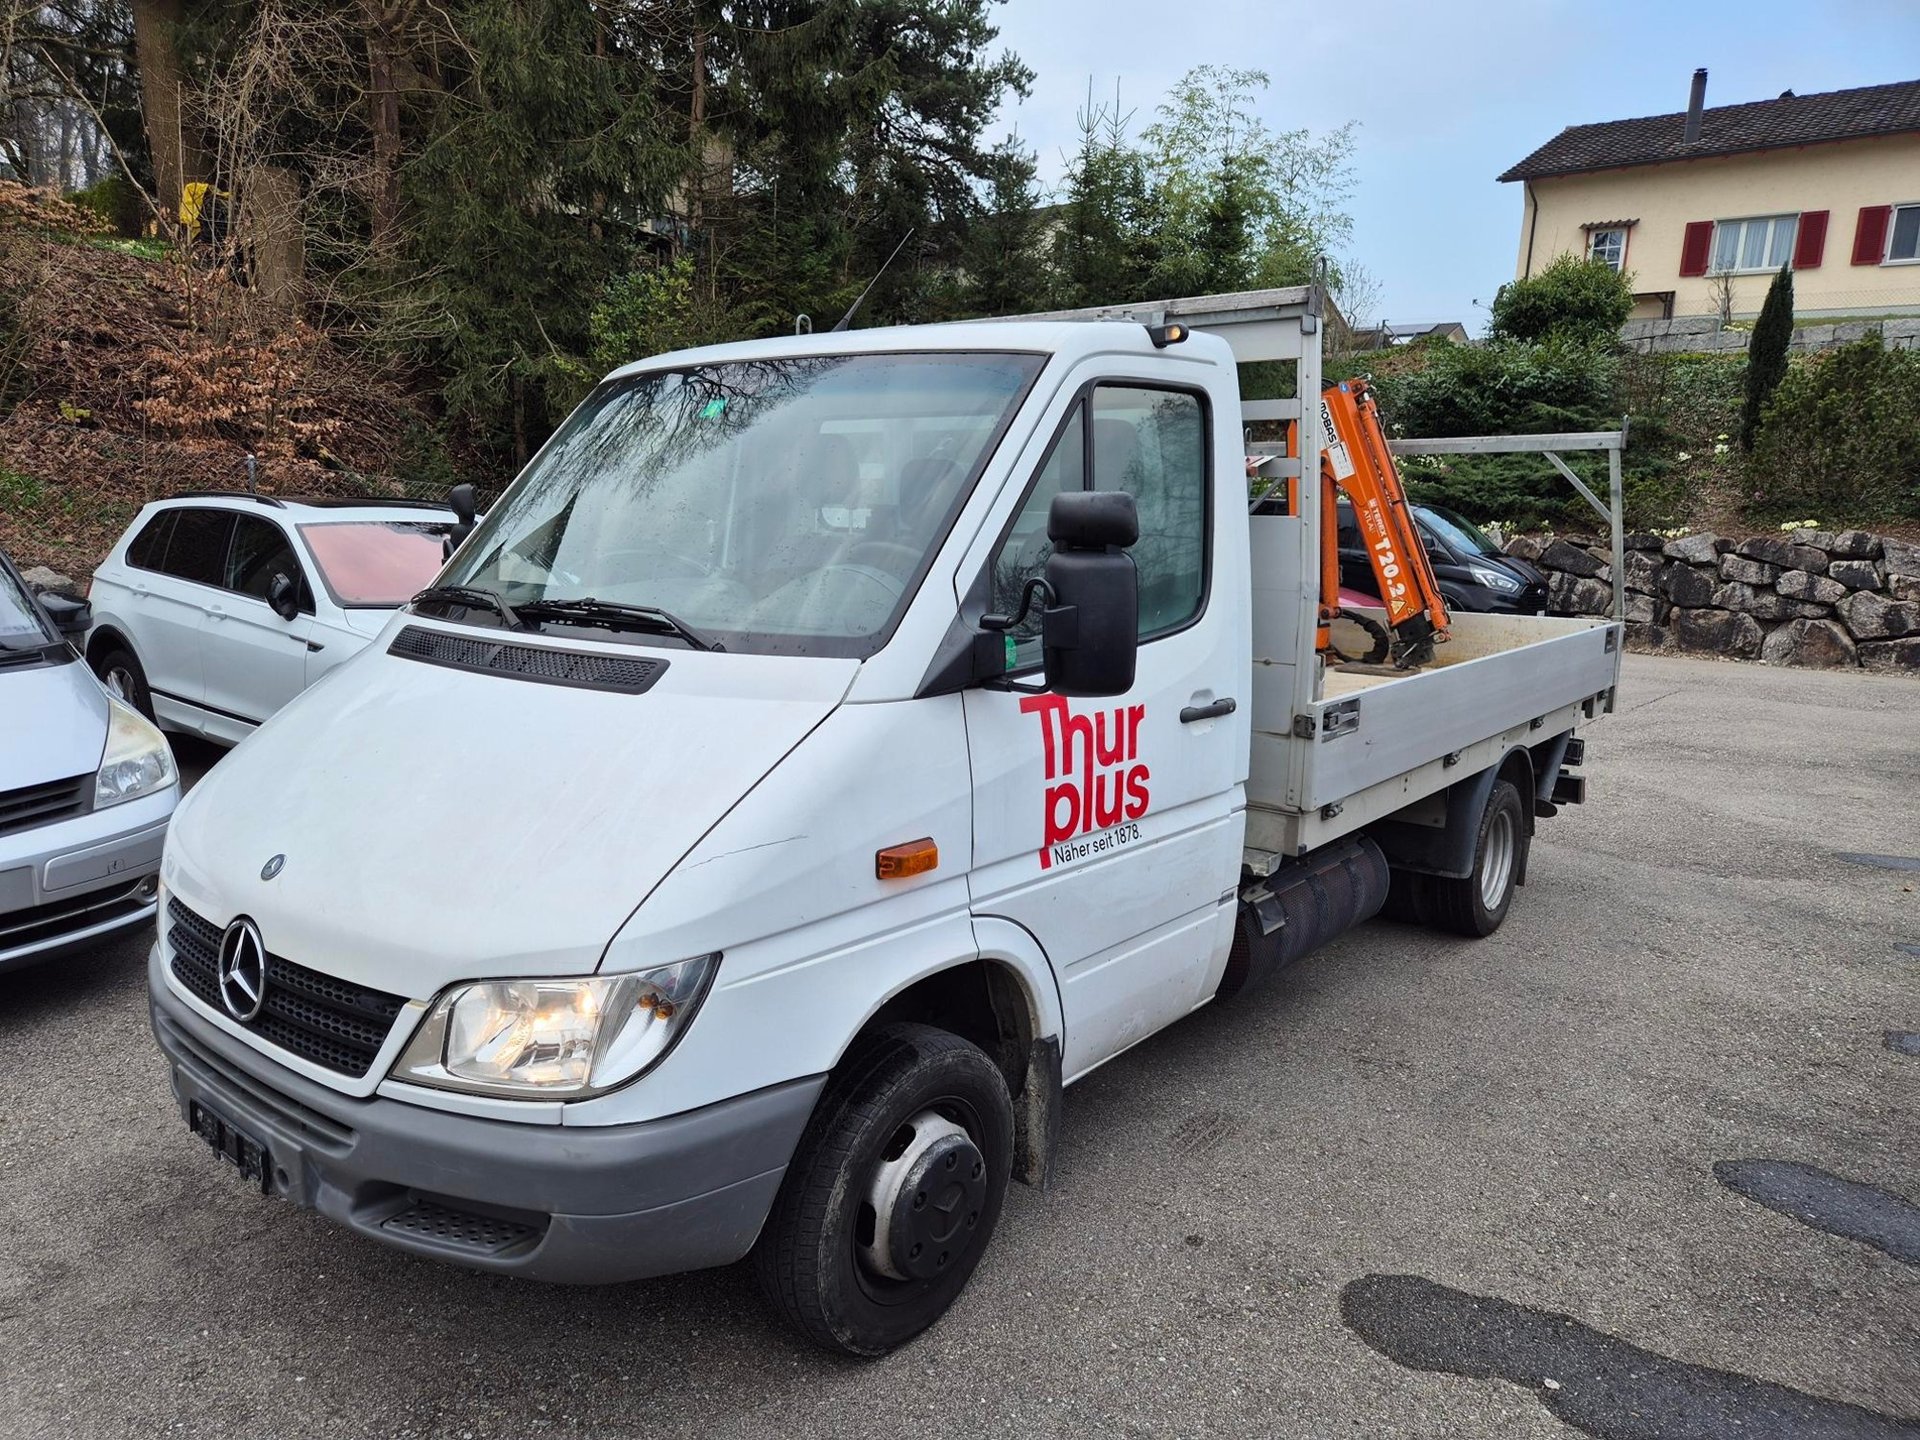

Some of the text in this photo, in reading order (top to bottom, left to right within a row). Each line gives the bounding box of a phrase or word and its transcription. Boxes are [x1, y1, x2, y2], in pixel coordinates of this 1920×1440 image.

[1372, 507, 1387, 537] TEREX
[1019, 693, 1145, 780] Thur
[1039, 764, 1150, 870] plus
[1054, 823, 1142, 865] Näher seit 1878.
